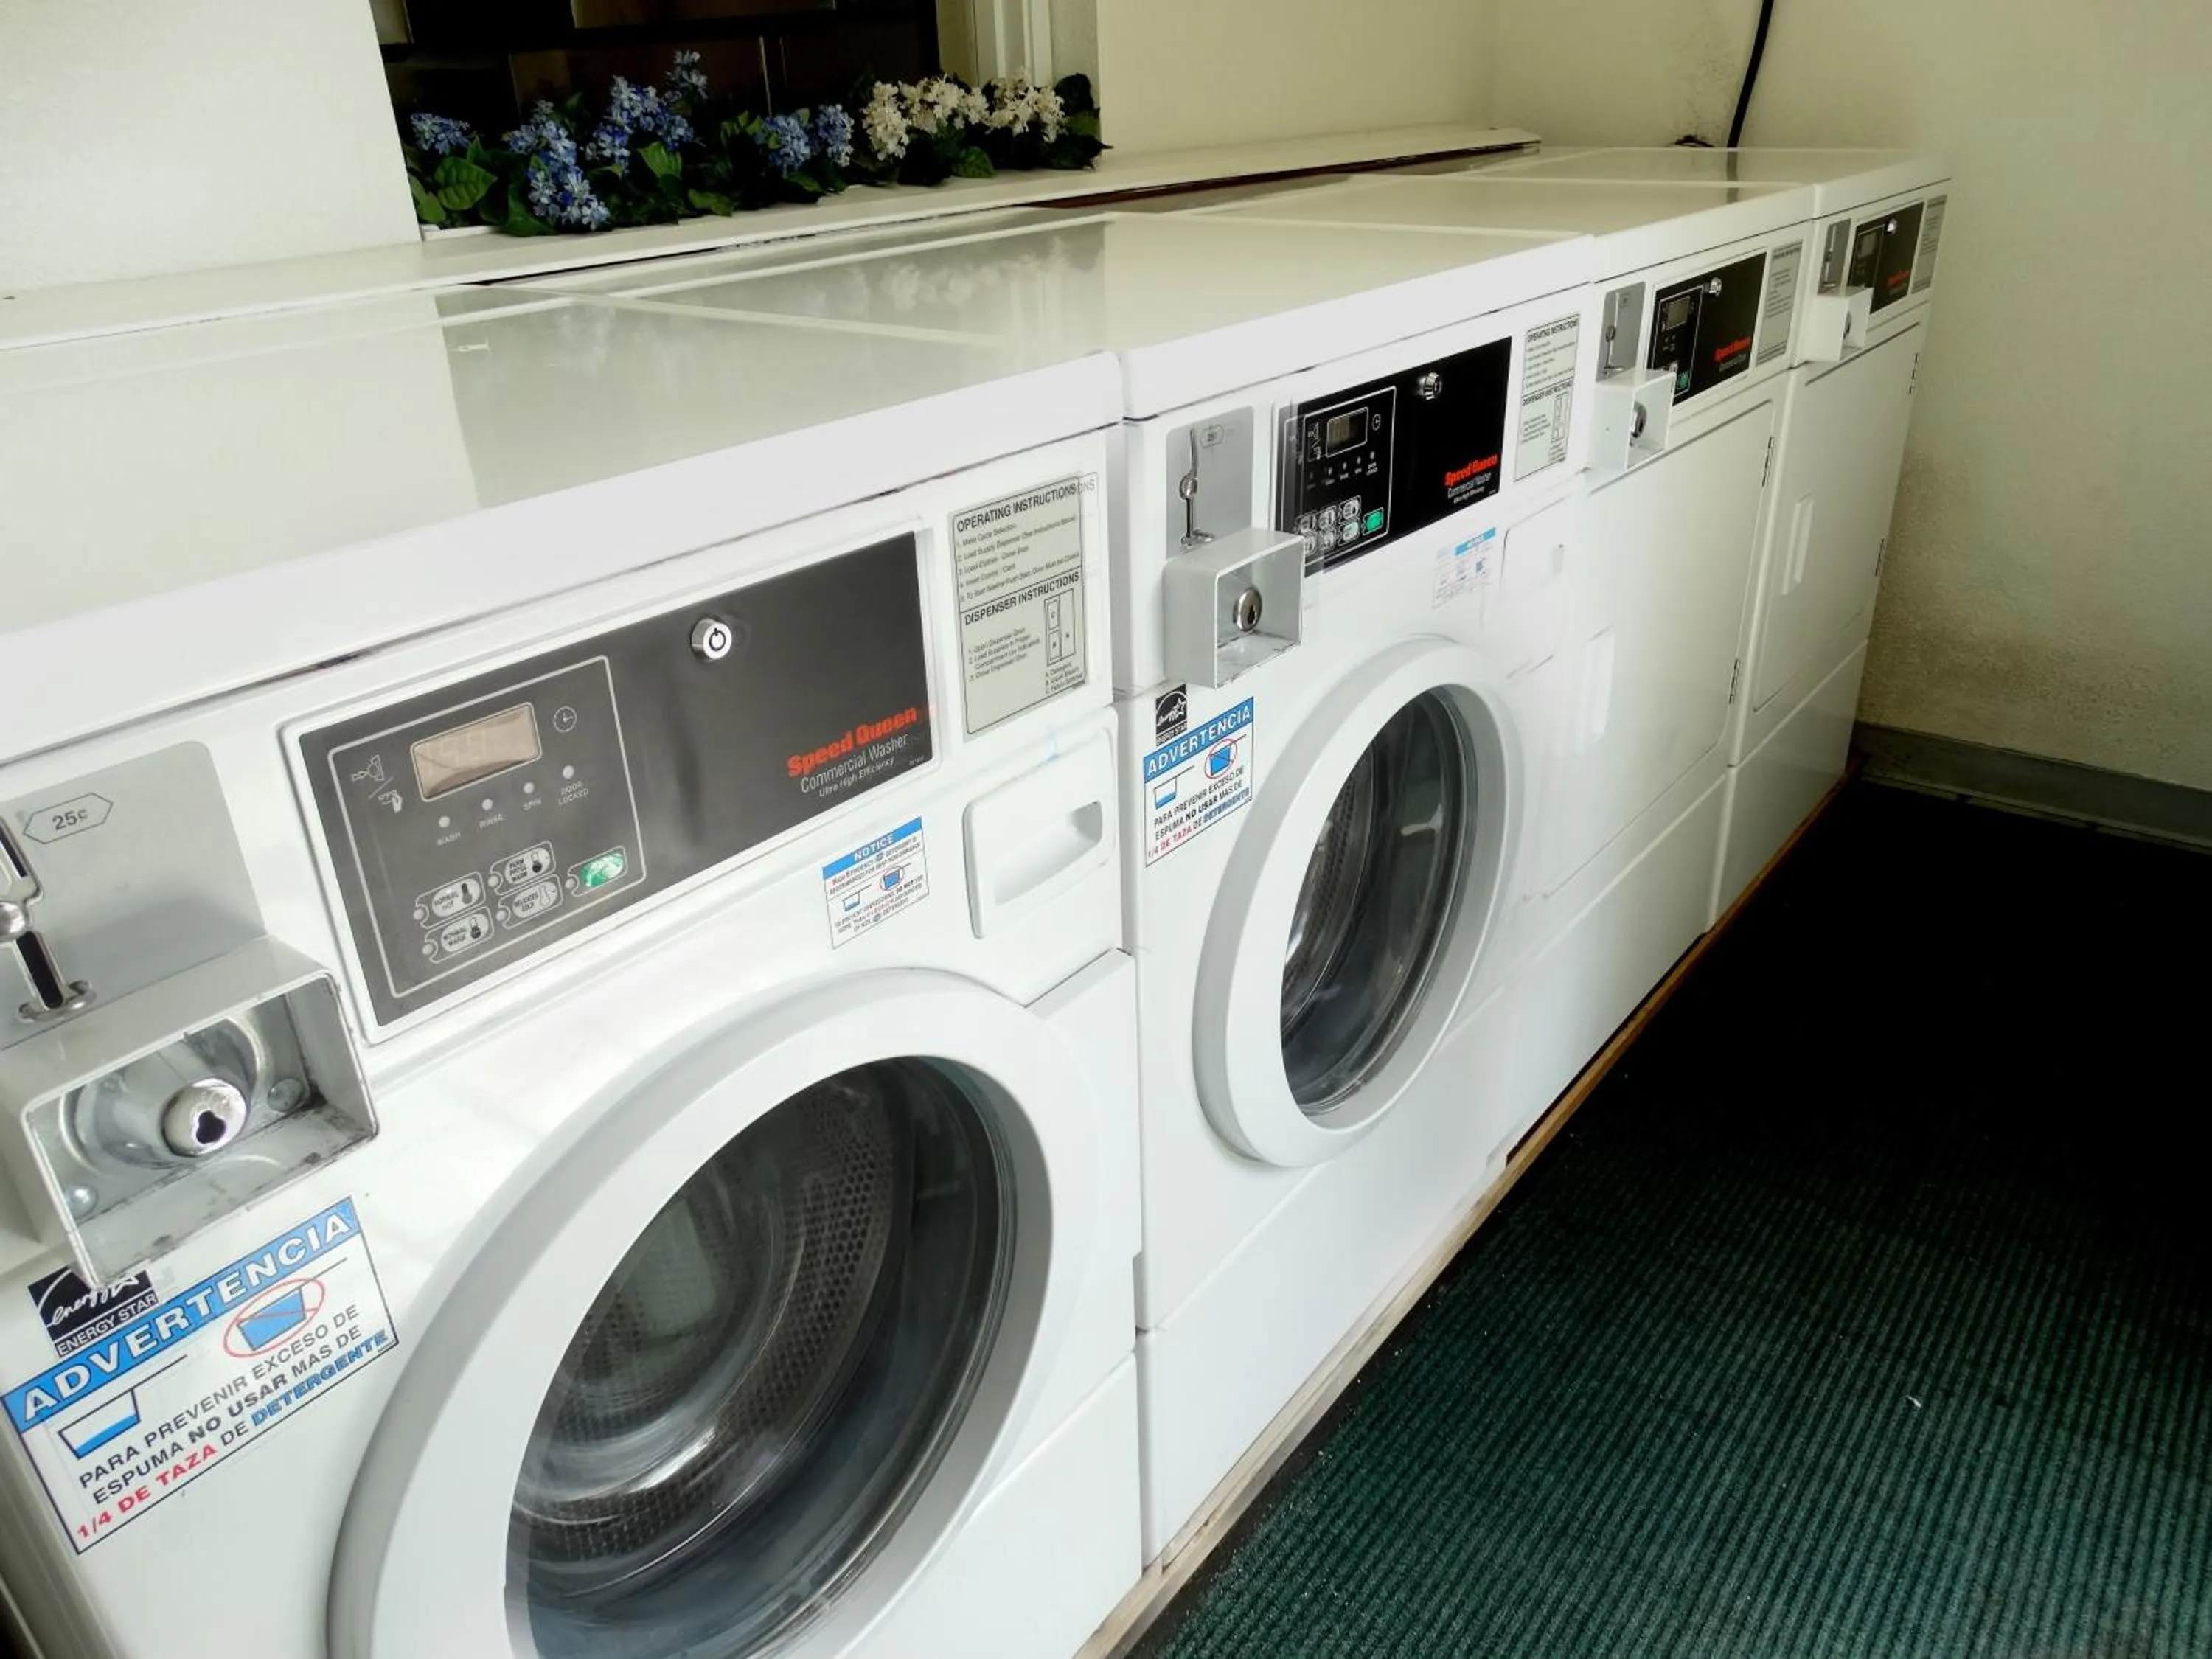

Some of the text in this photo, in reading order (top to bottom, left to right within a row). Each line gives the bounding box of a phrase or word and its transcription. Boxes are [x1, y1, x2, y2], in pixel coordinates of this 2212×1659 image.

[956, 483, 1077, 532] OPERATING INSTRUCTIONS
[965, 571, 1080, 626] DISPENSER INSTRUCTIONS
[787, 707, 918, 778] Speed Queen
[800, 732, 909, 793] Commercial Washer
[1147, 705, 1251, 776] ADVERTENCIA
[839, 776, 858, 789] High
[858, 757, 894, 779] Efficiency
[853, 833, 894, 862] NOTICE
[1155, 816, 1184, 841] ESPUMA
[1185, 808, 1197, 822] NO
[1197, 794, 1218, 813] USAR
[24, 1214, 352, 1422] ADVERTENCIA
[57, 1294, 159, 1356] ENERGY STAR
[79, 1304, 361, 1489] PARA PREVENIR EXCESO DE
[92, 1441, 184, 1505] ESPUMA
[187, 1416, 221, 1444] NO
[227, 1374, 288, 1418] USAR
[291, 1343, 333, 1378] MAS
[335, 1325, 363, 1349] DE
[77, 1511, 113, 1538] 1/4
[116, 1484, 152, 1512] DE
[155, 1444, 218, 1487] TAZA
[220, 1420, 249, 1446] DE
[251, 1328, 389, 1427] DETERGENTE
